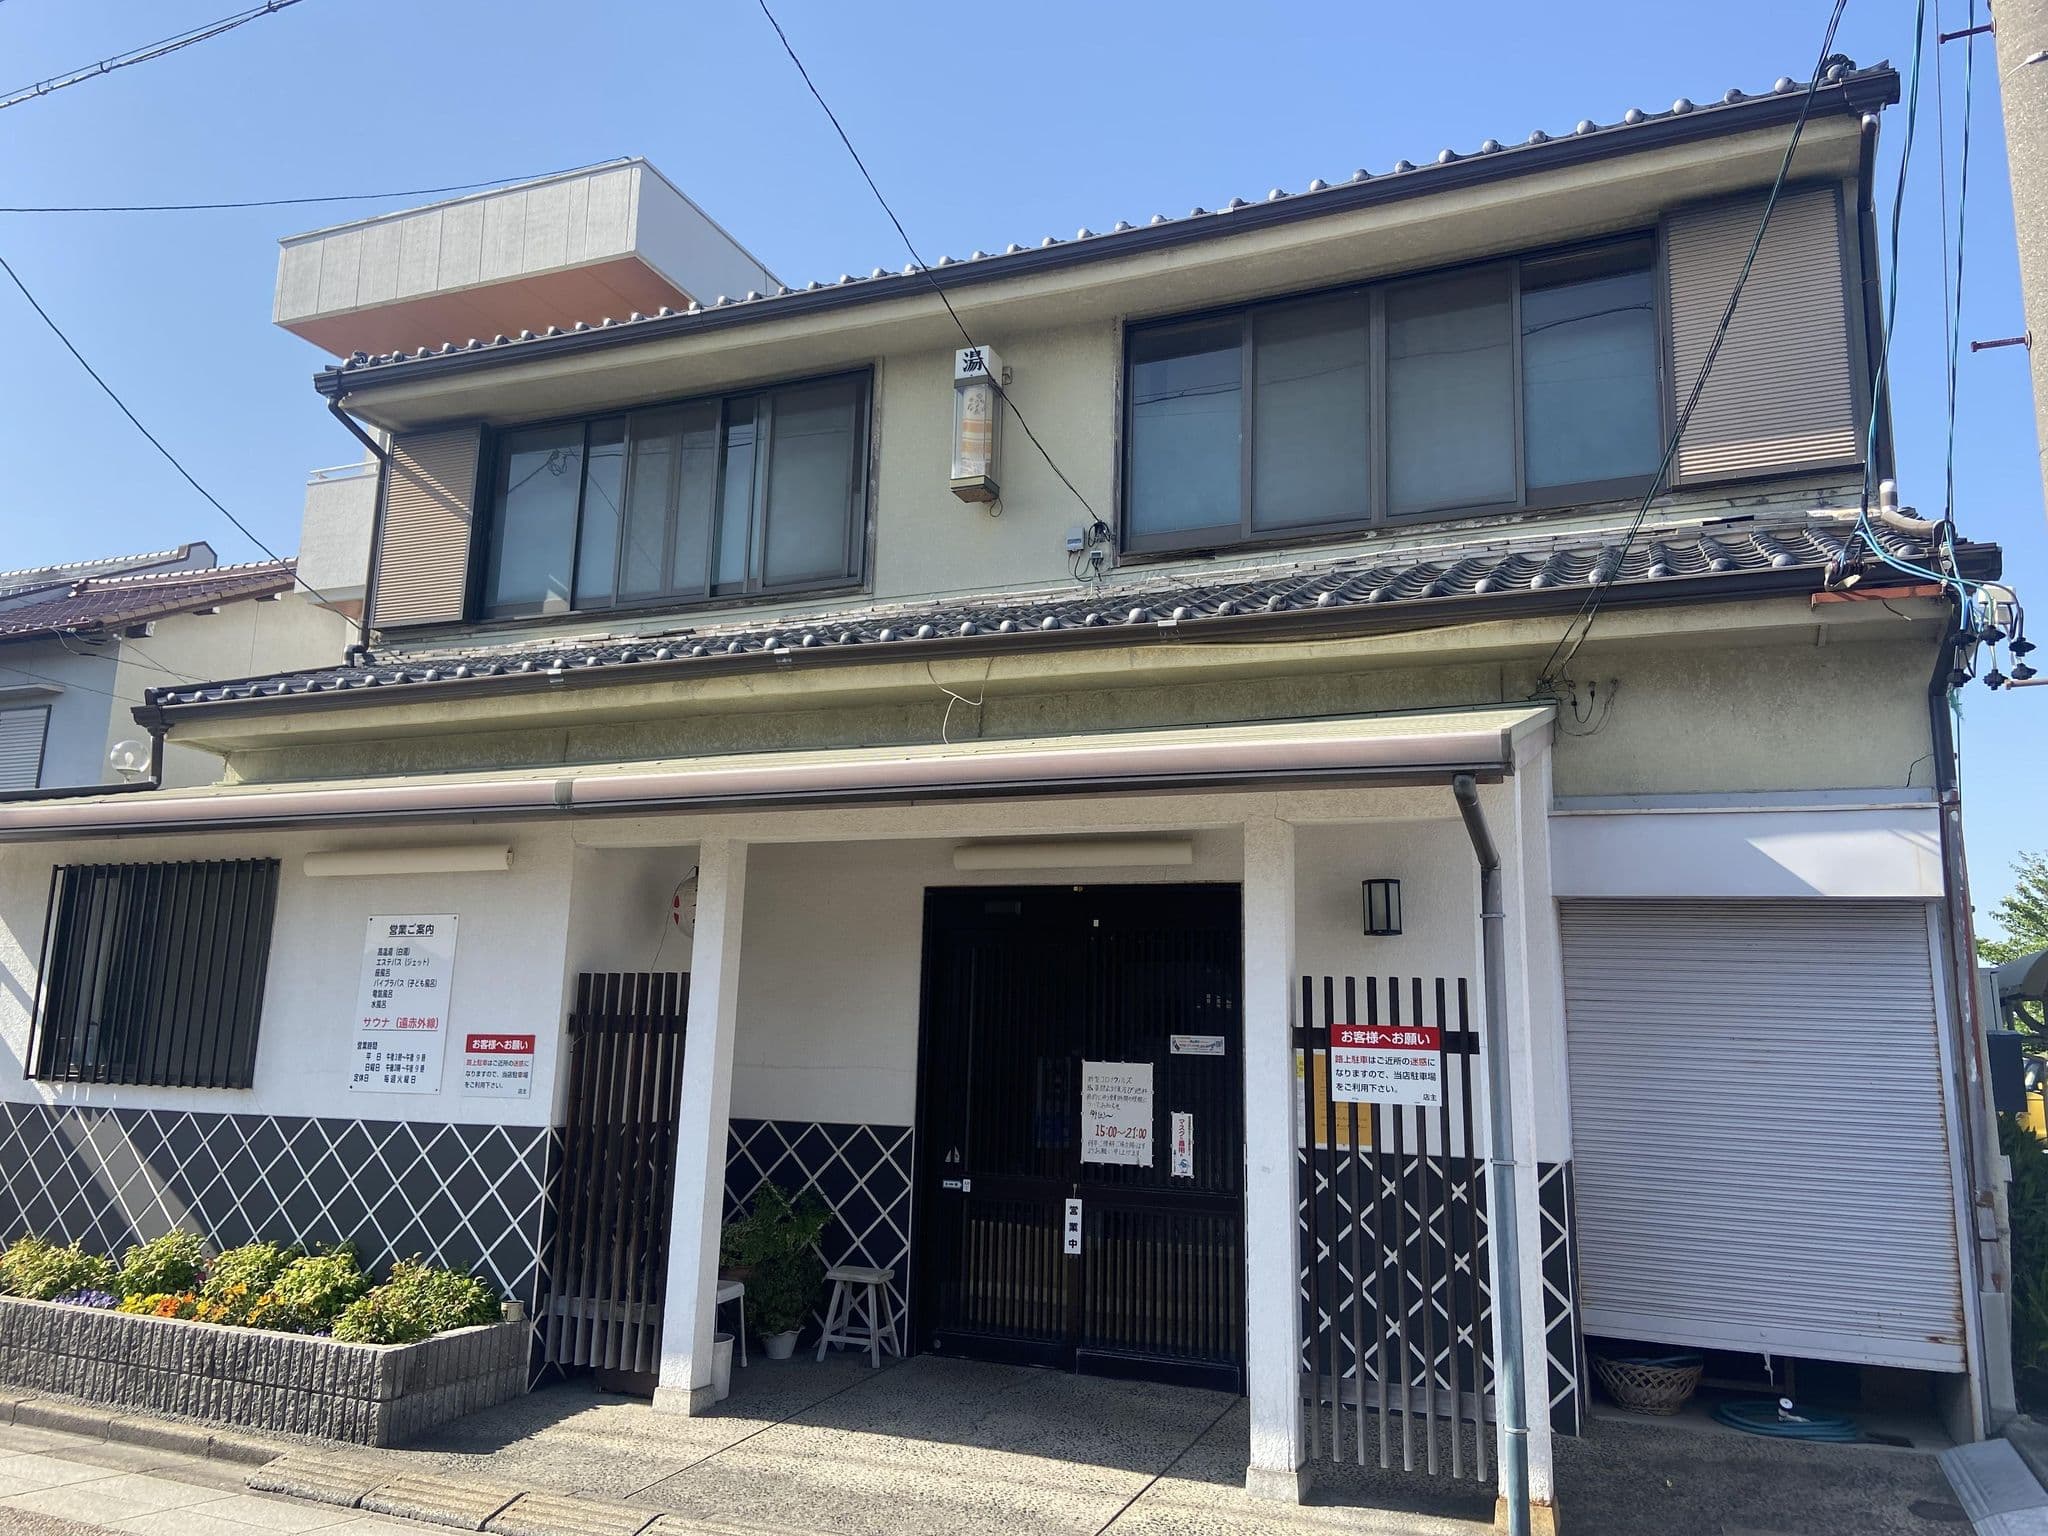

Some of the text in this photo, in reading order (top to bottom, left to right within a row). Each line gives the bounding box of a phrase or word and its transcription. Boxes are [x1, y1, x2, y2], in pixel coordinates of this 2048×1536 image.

[962, 350, 984, 372] 湯
[388, 923, 434, 936] 営業ご案内
[472, 1039, 529, 1050] お客様へお願い
[1341, 1030, 1430, 1046] お客様へお願い
[1335, 1054, 1436, 1067] 路上駐車はご近所の迷惑に
[352, 1073, 369, 1082] 定休日
[1335, 1069, 1437, 1082] なりますので、当店駐車場
[1336, 1082, 1398, 1094] をご利用下さい。
[1422, 1093, 1437, 1102] 店主
[1068, 1205, 1079, 1249] 営業中
